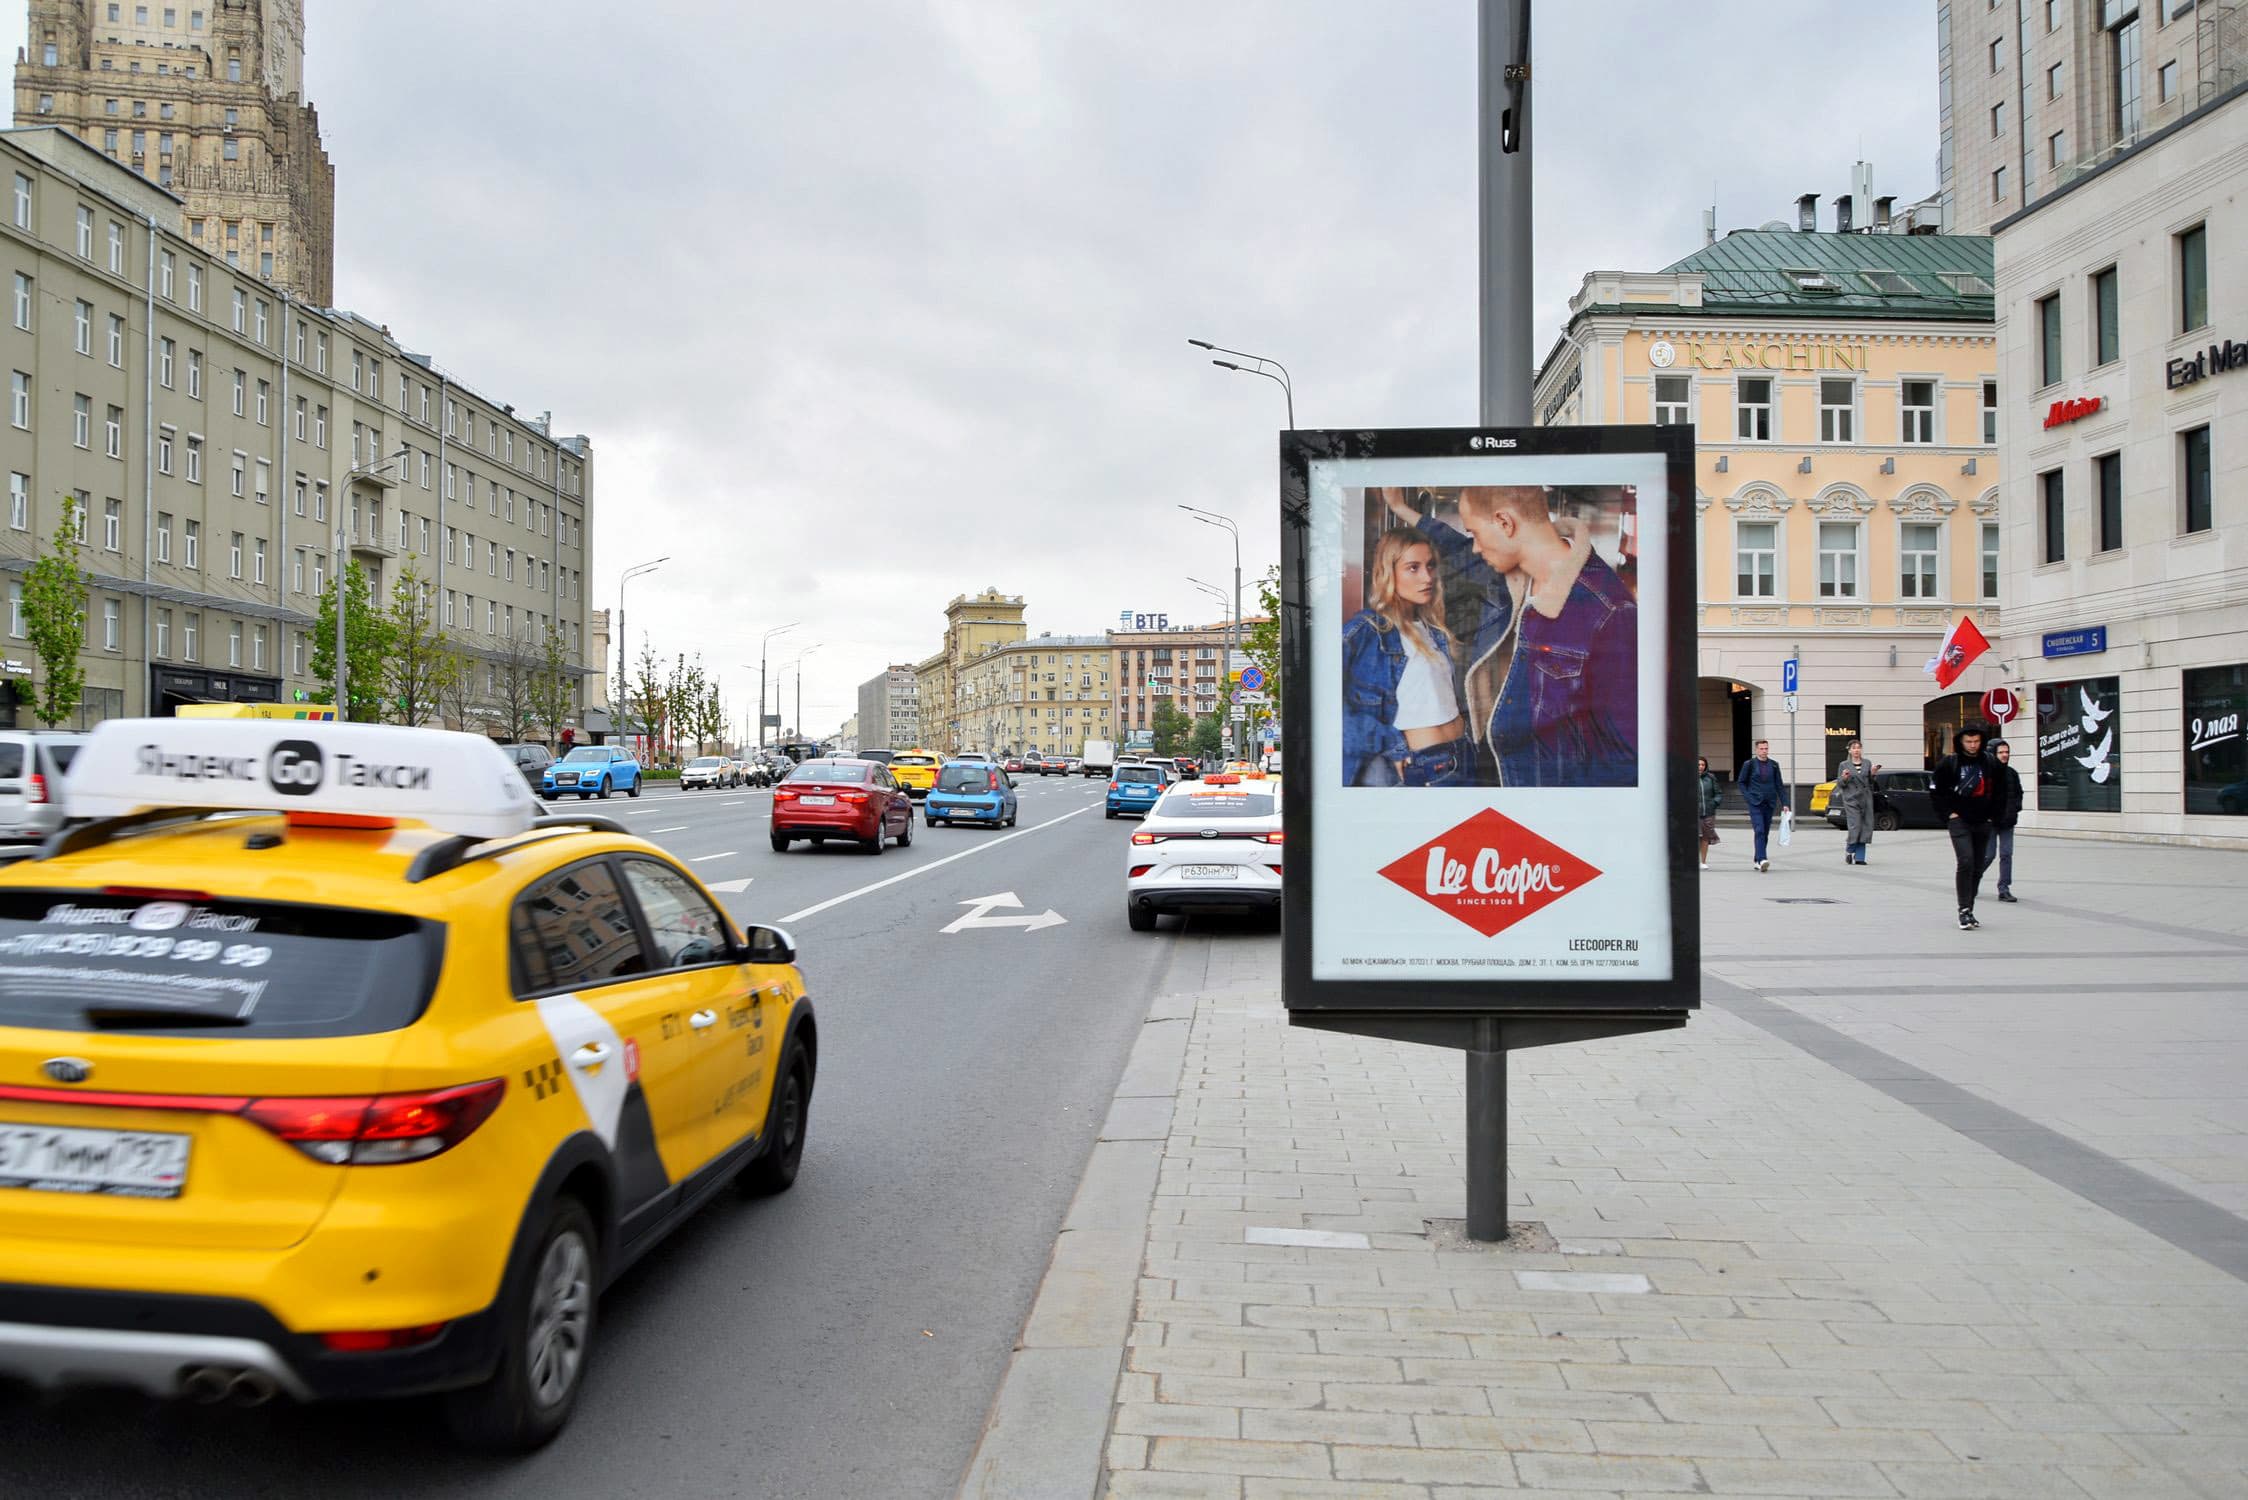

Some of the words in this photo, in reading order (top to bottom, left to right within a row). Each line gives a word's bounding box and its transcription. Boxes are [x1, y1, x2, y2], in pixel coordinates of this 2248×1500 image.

[1689, 342, 1869, 372] RASCHINI
[2166, 350, 2206, 390] Eat
[2209, 339, 2248, 375] Ma
[1485, 436, 1517, 448] Russ
[1135, 613, 1169, 629] ВТБ
[2091, 633, 2098, 647] 5
[2040, 735, 2048, 747] 78
[2060, 730, 2067, 738] со
[2191, 718, 2202, 744] 9
[2204, 713, 2238, 738] мая
[136, 743, 257, 783] Яндекс
[271, 749, 322, 786] Go
[334, 753, 431, 790] Такси
[1425, 846, 1468, 895] Lee
[1569, 939, 1639, 951] LEECOOPER.RU
